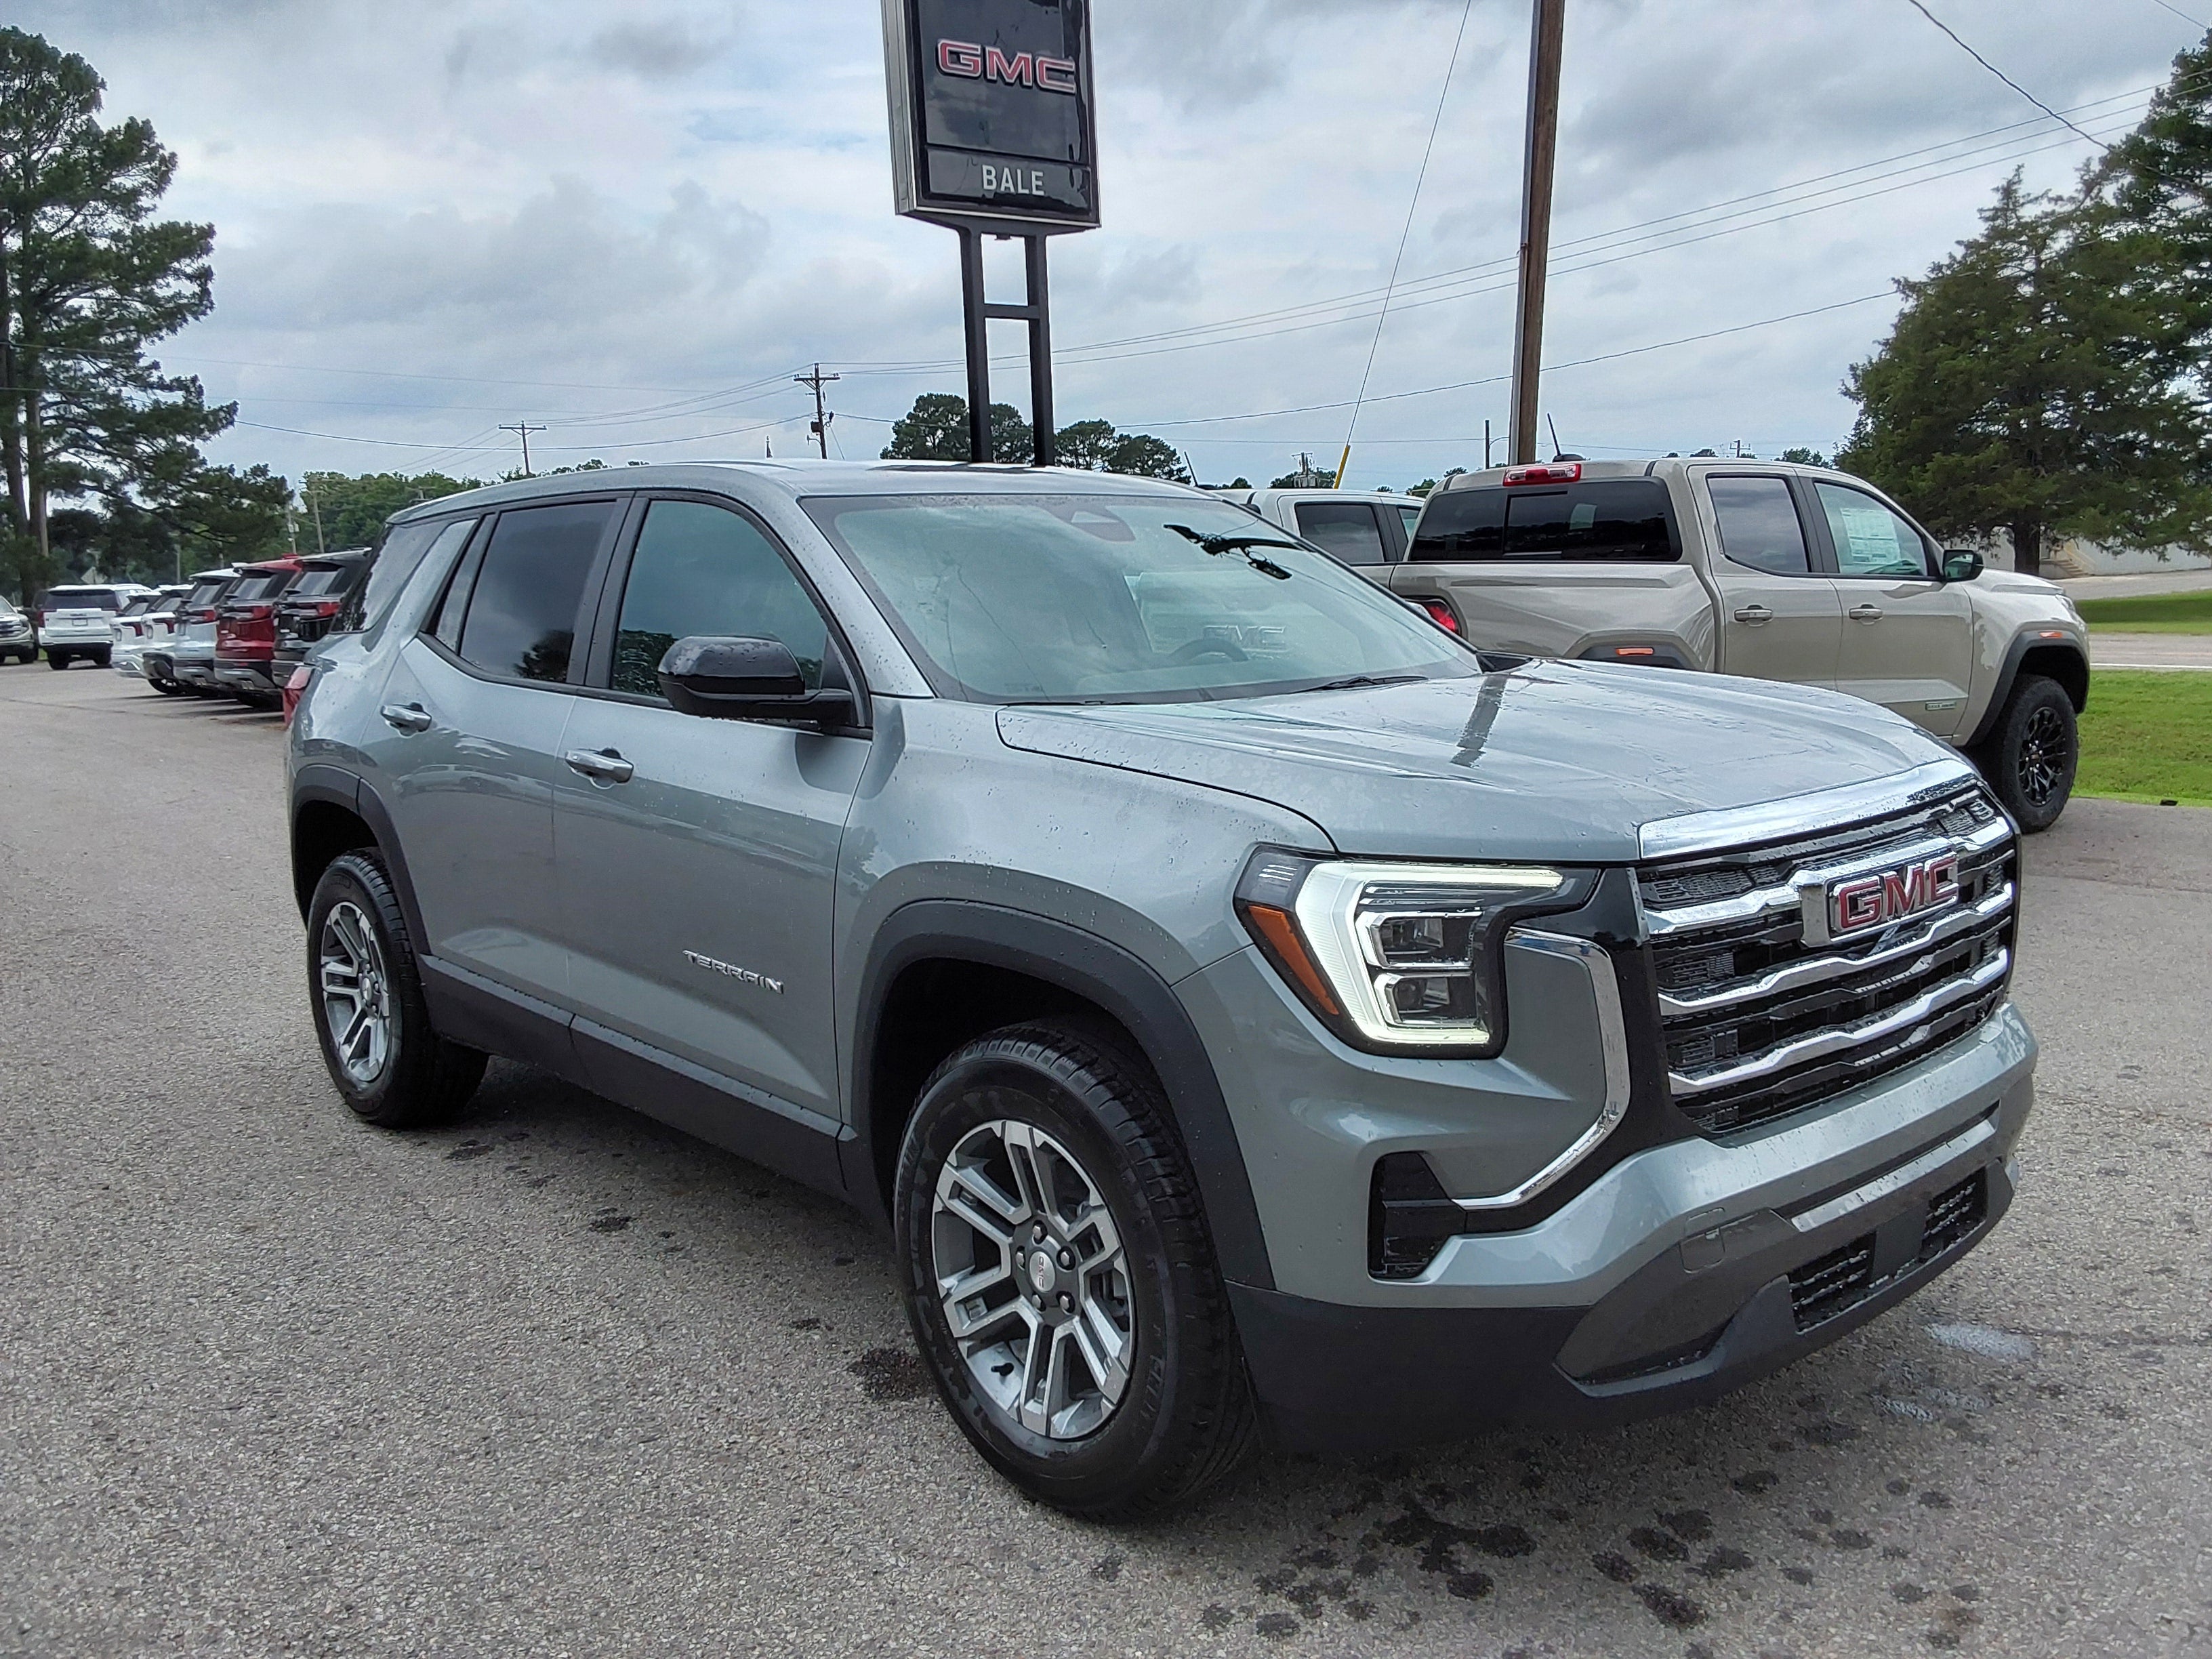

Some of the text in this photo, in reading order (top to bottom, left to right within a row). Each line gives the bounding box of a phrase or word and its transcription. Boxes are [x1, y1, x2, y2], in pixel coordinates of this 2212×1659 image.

[938, 39, 1076, 94] GMC
[983, 165, 1045, 196] BALE
[1832, 852, 1959, 933] GMC
[682, 949, 784, 994] TERRAIN
